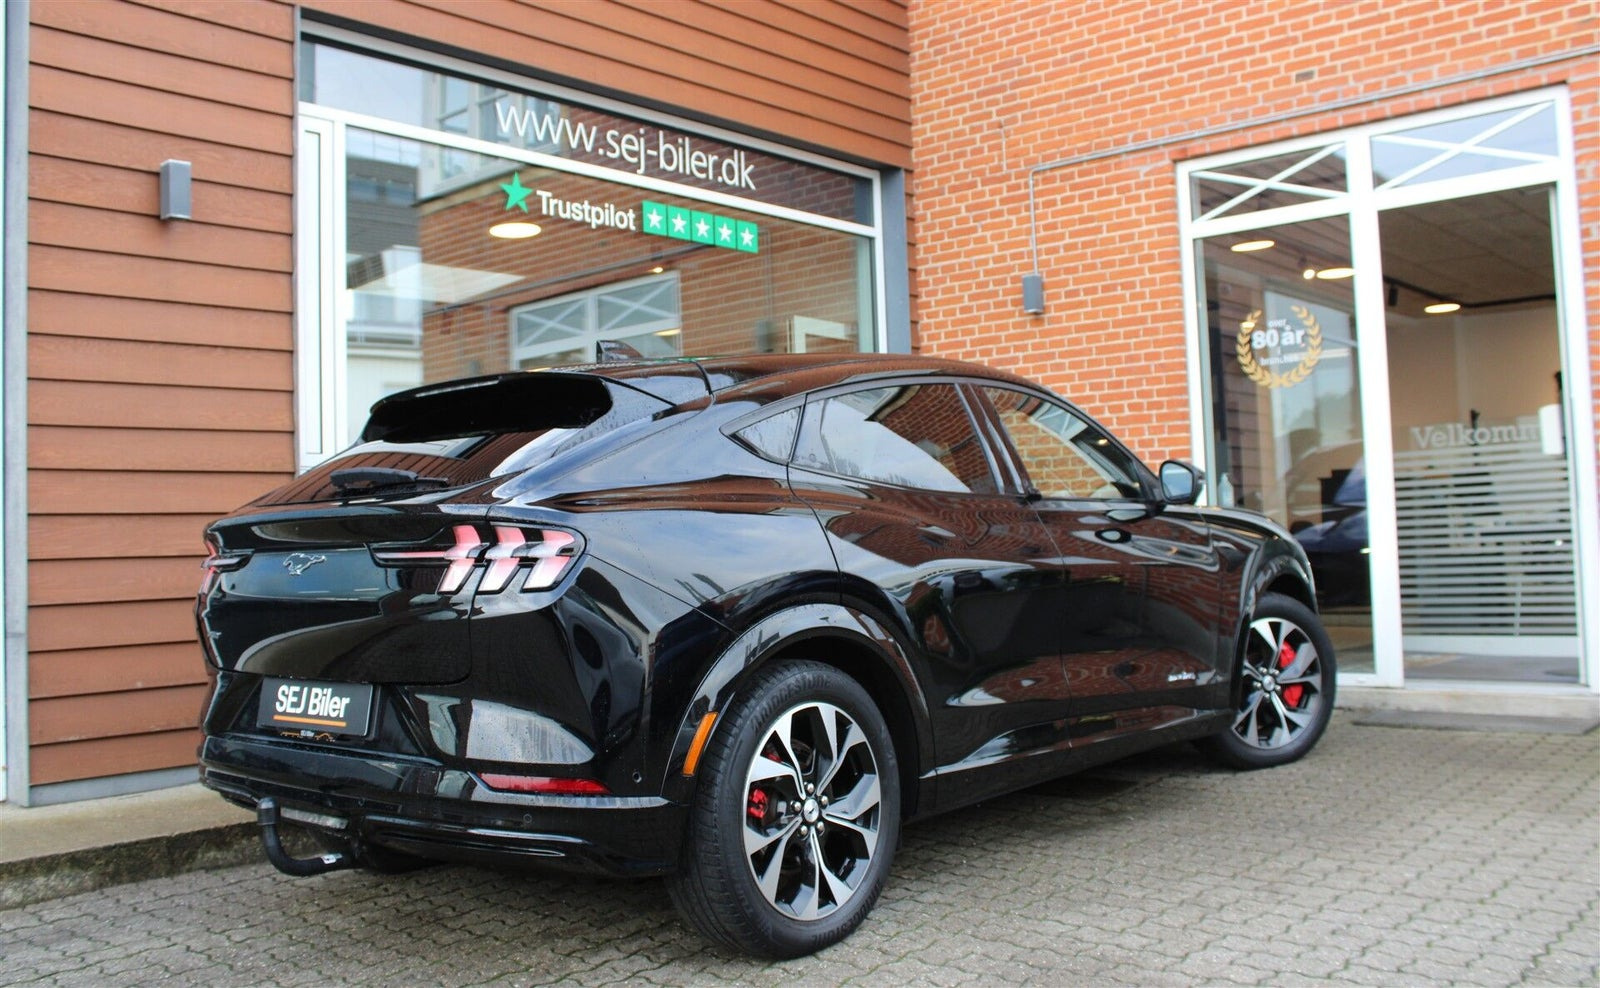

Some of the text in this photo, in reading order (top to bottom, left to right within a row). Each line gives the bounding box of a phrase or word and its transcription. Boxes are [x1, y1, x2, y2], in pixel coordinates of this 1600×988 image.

[495, 102, 756, 190] www.sej-biler.dk
[536, 190, 636, 231] Trustpilot
[1251, 325, 1304, 349] 80 år
[1411, 423, 1538, 448] Velkomm
[275, 684, 351, 718] SEJ Biler
